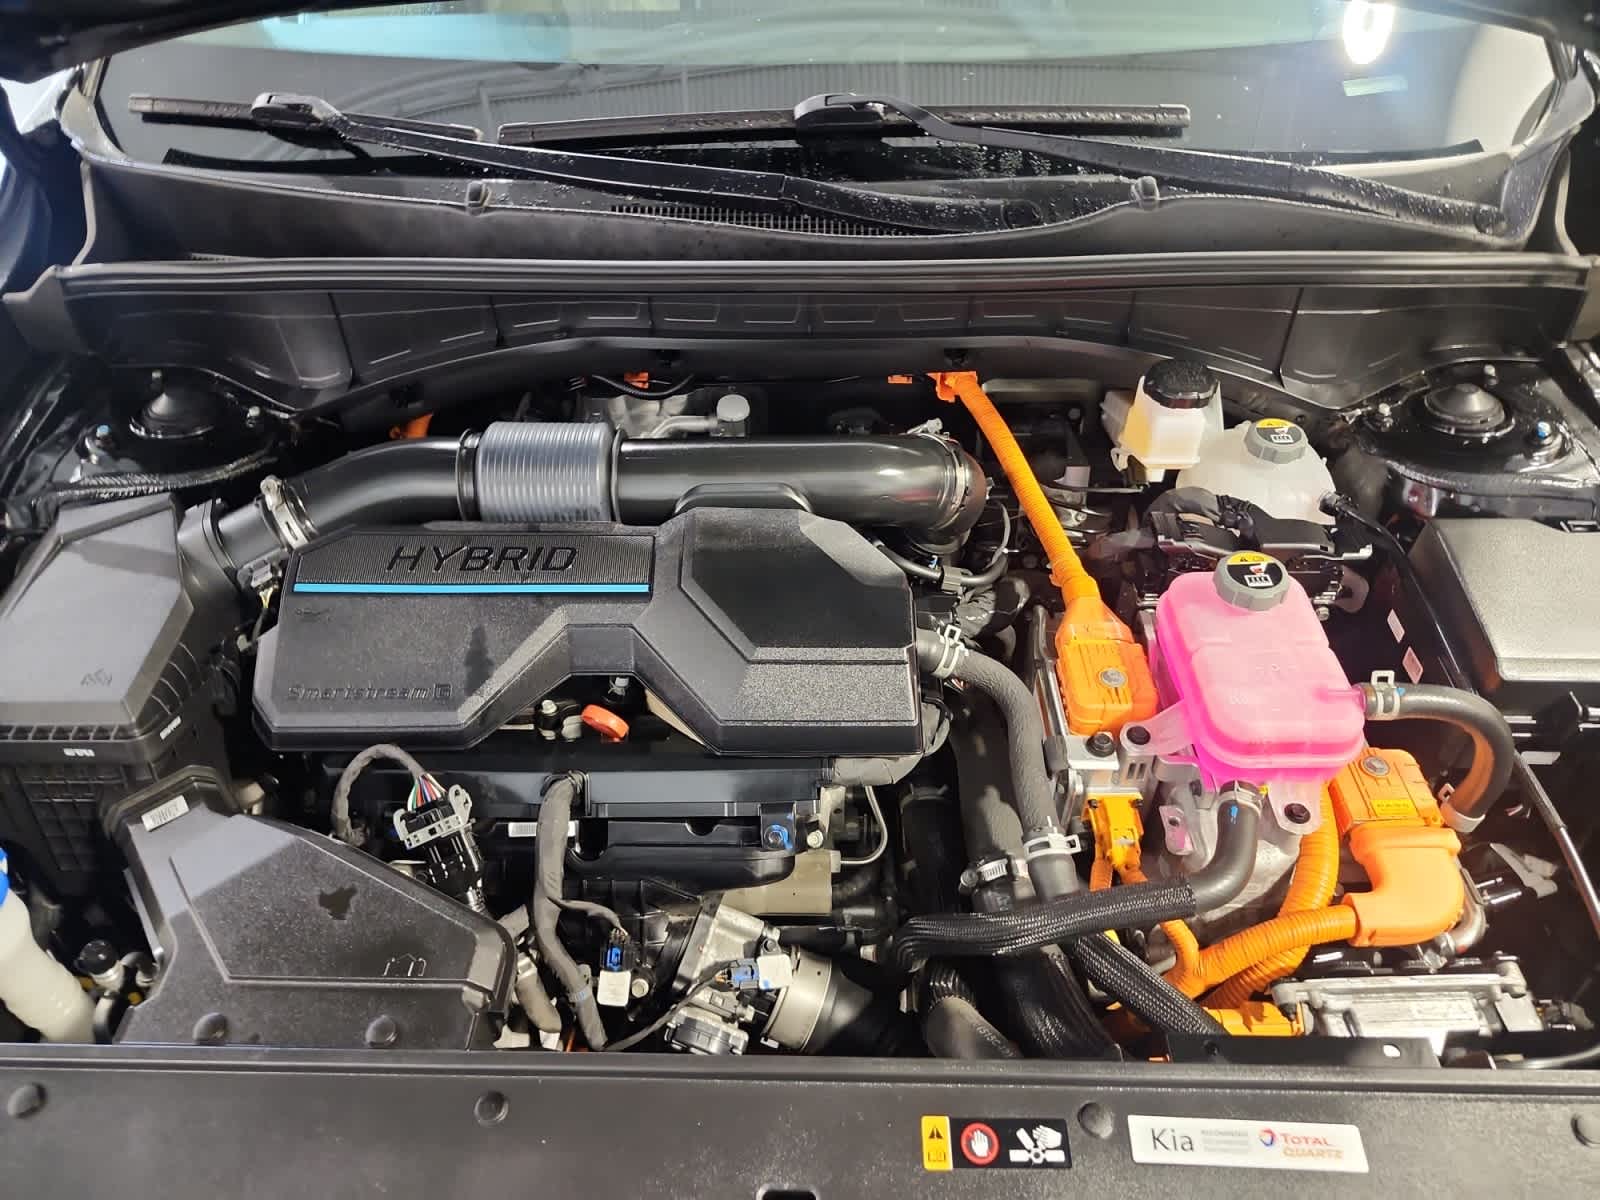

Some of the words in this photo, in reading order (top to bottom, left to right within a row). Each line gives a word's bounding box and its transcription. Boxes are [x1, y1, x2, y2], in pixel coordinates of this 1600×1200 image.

[386, 545, 578, 572] HYBRID
[287, 681, 429, 700] Smartstream
[1151, 1127, 1194, 1152] Kia
[1280, 1132, 1332, 1146] TOTAL
